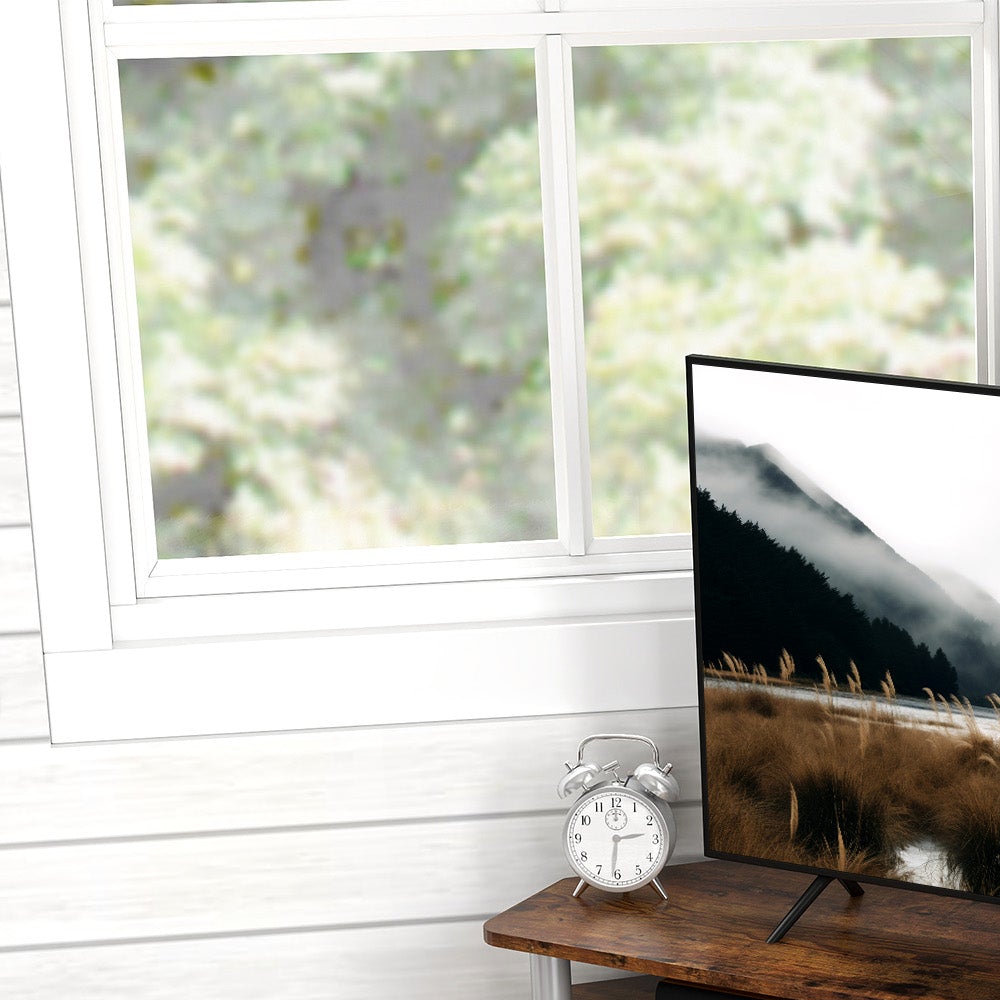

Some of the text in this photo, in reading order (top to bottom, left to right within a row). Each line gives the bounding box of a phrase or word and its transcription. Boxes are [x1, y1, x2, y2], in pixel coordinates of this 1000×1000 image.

[595, 802, 603, 813] 11
[611, 797, 622, 808] 12
[633, 802, 637, 813] 1
[581, 815, 591, 826] 10
[646, 815, 653, 826] 2
[574, 833, 582, 844] 9
[652, 834, 659, 845] 3
[580, 851, 588, 862] 8
[646, 852, 653, 862] 4
[595, 865, 602, 875] 7
[614, 869, 622, 880] 6
[635, 865, 642, 875] 5
